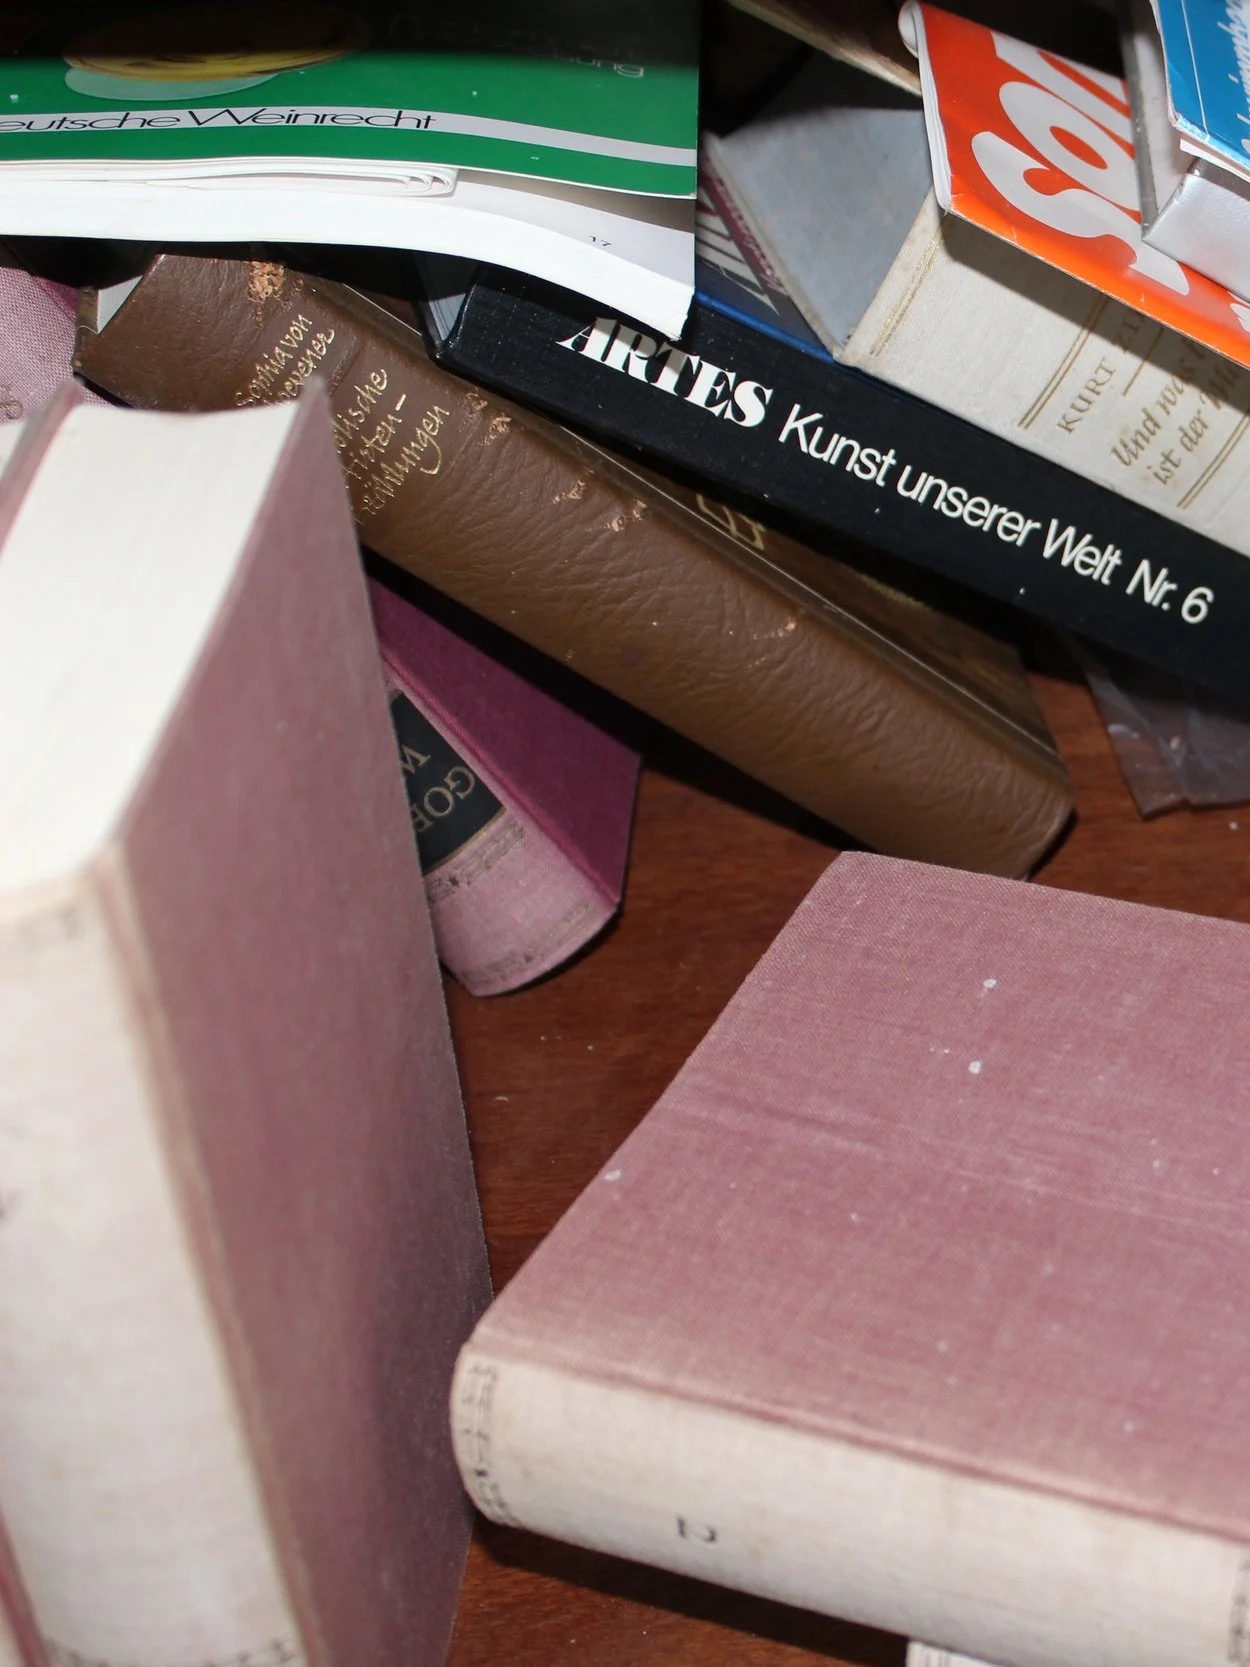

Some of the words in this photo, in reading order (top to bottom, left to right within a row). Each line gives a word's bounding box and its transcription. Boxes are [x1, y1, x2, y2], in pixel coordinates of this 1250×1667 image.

[188, 108, 436, 130] Weinrecht
[281, 313, 313, 352] von
[1056, 355, 1117, 434] KURT
[1110, 407, 1163, 468] Und
[1159, 357, 1197, 416] was
[556, 316, 774, 428] ARTES
[777, 403, 897, 487] Kunst
[896, 464, 1041, 547] unserer
[1041, 518, 1123, 585] Welt
[1125, 558, 1178, 611] Nr.
[1180, 586, 1215, 625] 6
[1146, 447, 1182, 486] ist
[1178, 409, 1210, 453] der
